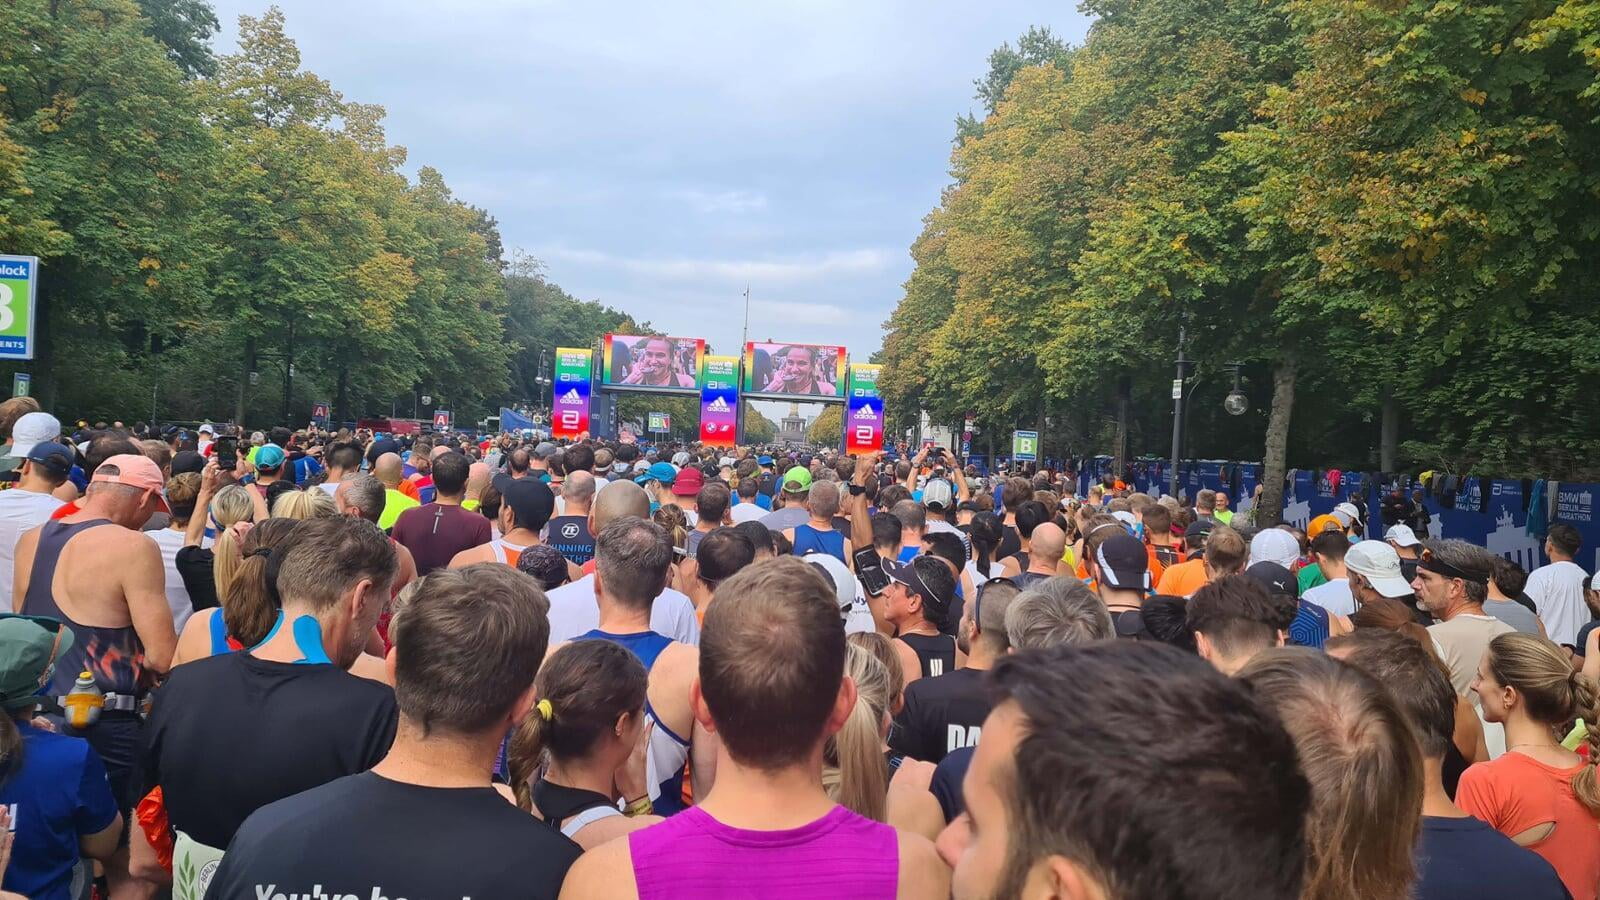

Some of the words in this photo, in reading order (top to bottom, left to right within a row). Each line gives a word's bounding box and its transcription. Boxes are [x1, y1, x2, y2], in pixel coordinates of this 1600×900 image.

[315, 406, 323, 416] A
[437, 415, 445, 425] A
[652, 417, 660, 427] B
[1020, 438, 1032, 452] B
[1558, 492, 1579, 503] BMW
[1557, 503, 1579, 511] BERLIN
[1557, 511, 1592, 522] MARATHON
